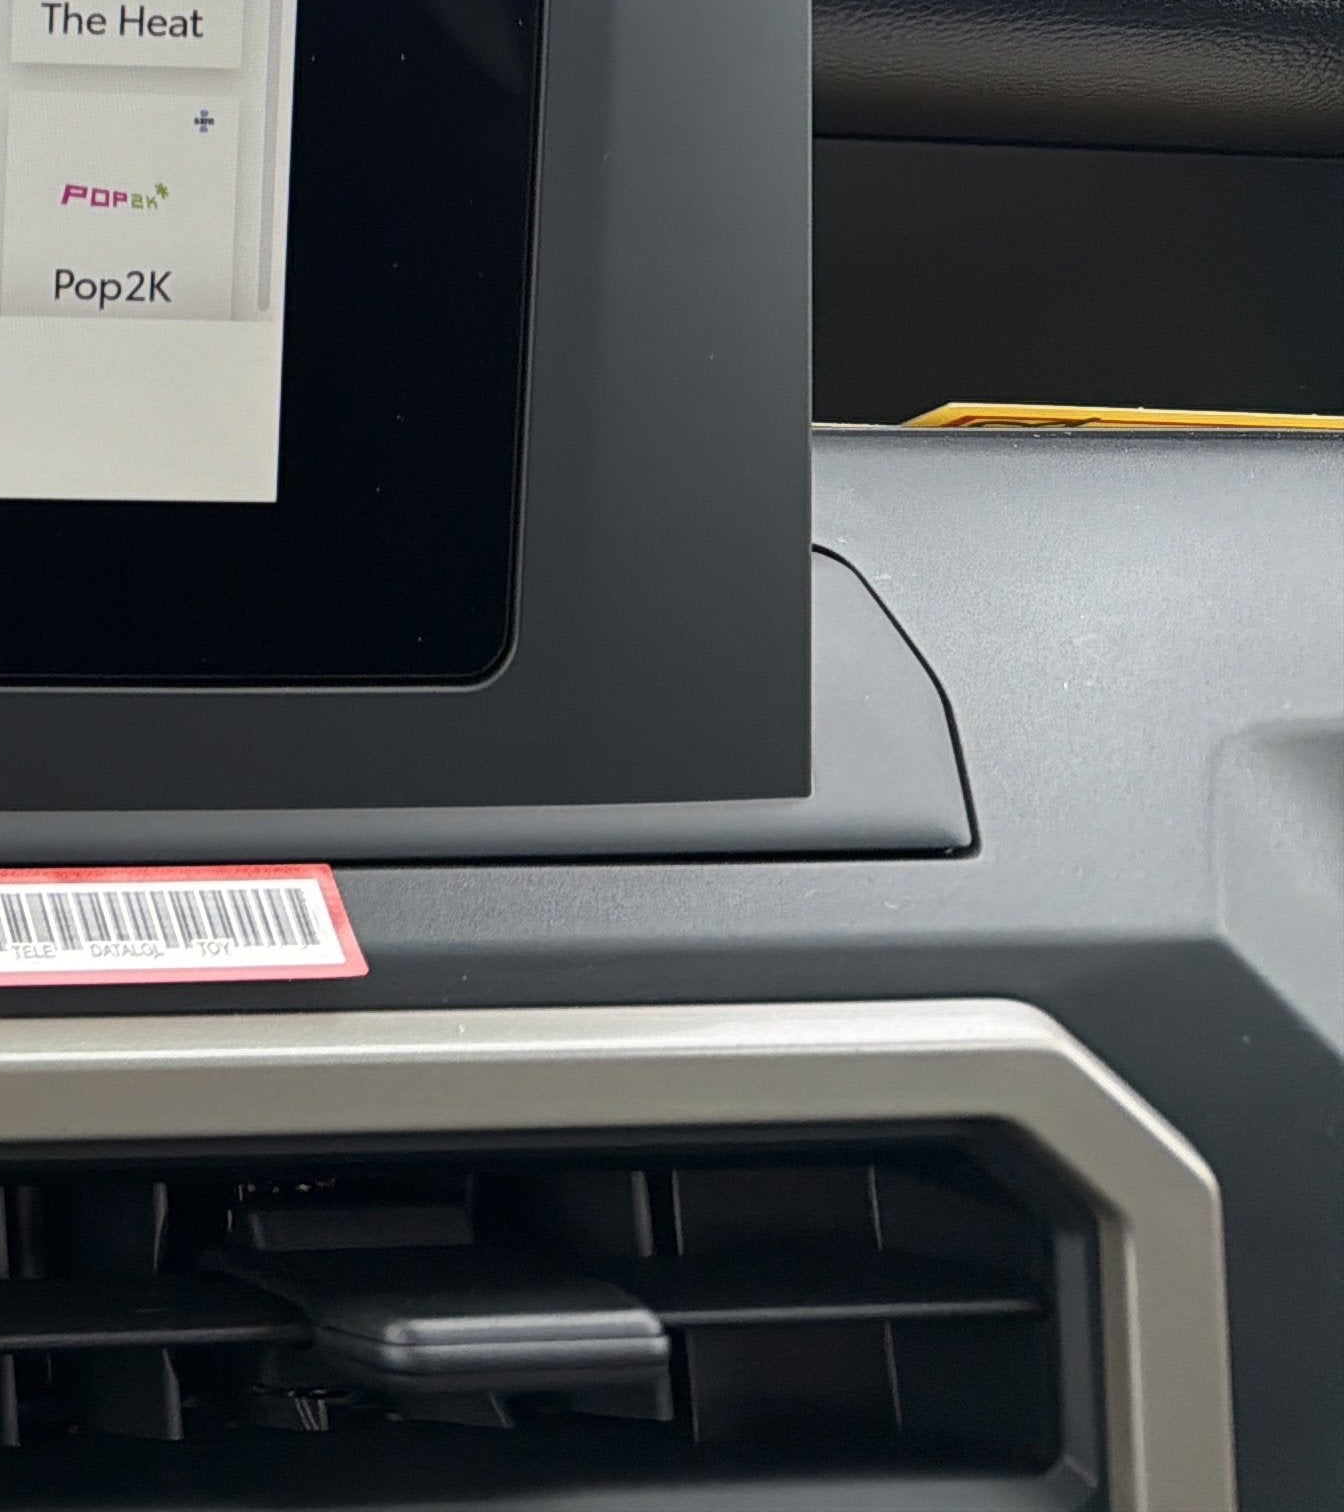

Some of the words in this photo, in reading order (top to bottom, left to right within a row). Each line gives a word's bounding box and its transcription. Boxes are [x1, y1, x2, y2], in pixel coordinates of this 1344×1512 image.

[41, 2, 107, 37] The
[119, 5, 204, 39] Heat
[53, 268, 173, 312] Pop2K
